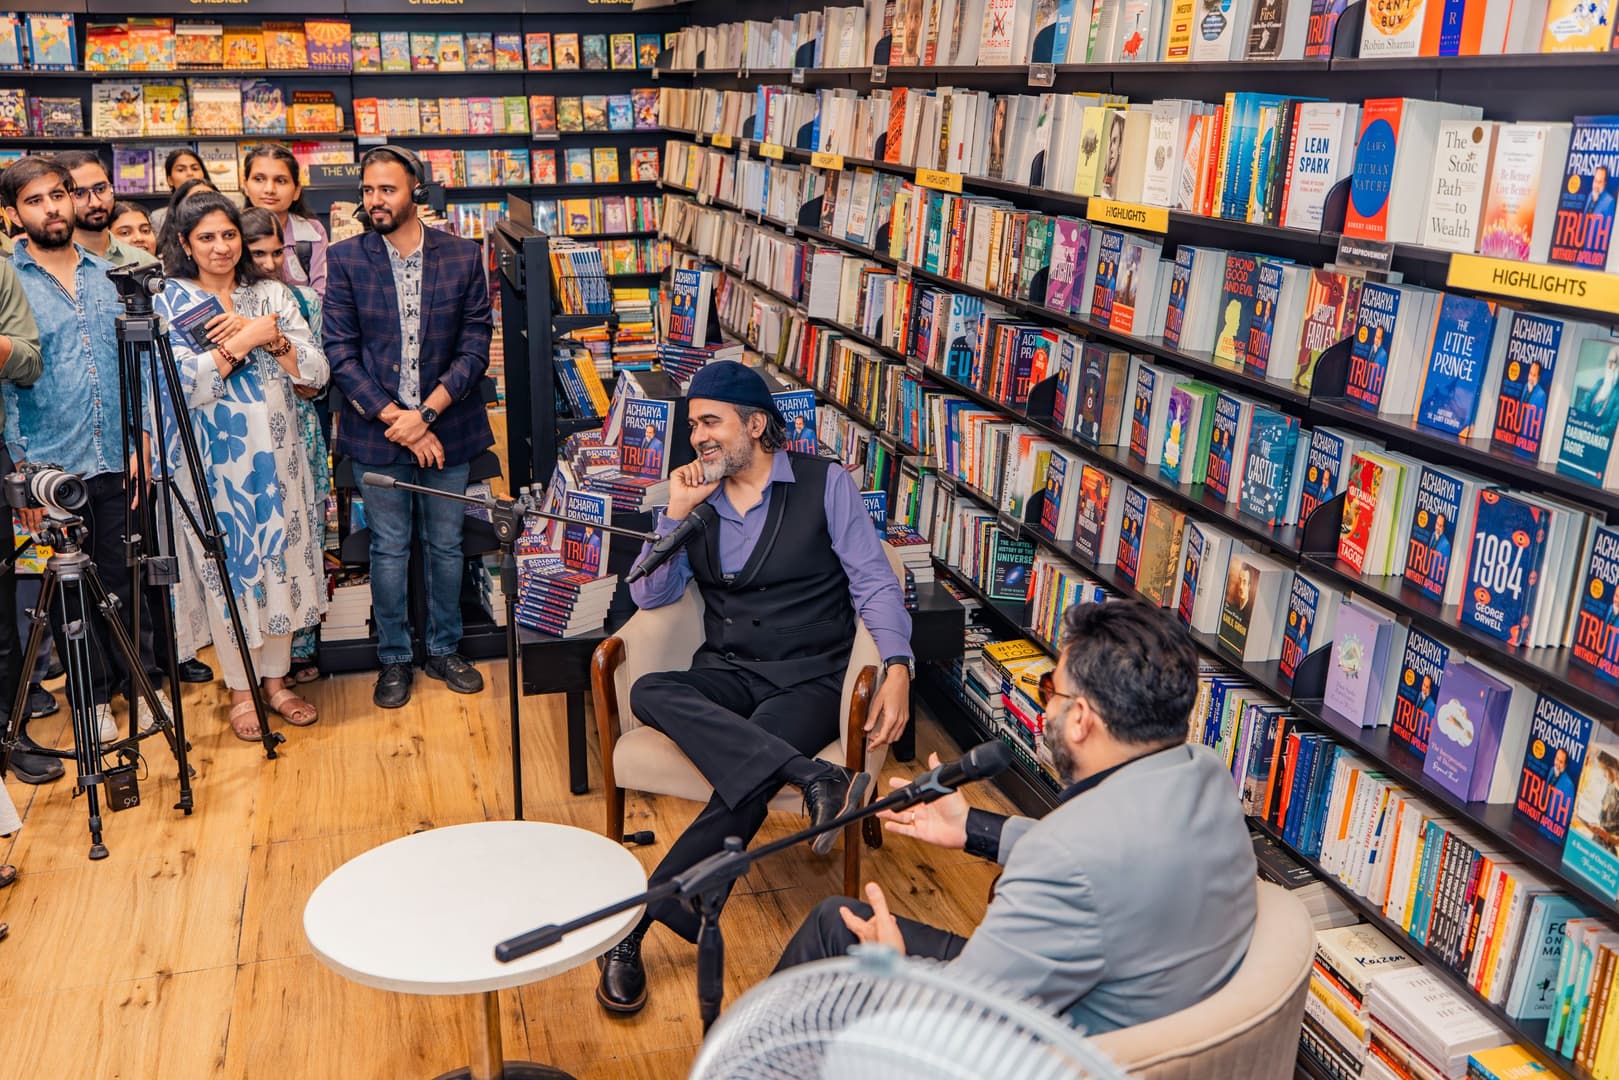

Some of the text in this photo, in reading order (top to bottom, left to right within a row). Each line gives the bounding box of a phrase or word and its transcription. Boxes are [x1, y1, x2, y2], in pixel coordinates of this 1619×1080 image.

[1308, 13, 1338, 44] TRUT
[1381, 15, 1404, 28] BUY
[311, 52, 349, 64] SIKHS
[1305, 137, 1330, 154] LEAN
[1366, 141, 1386, 150] LAWS
[1446, 130, 1468, 150] The
[320, 166, 343, 176] THE
[1300, 157, 1330, 174] SPARK
[1357, 164, 1389, 176] HUMAN
[1448, 154, 1478, 174] Stoic
[1354, 180, 1388, 192] NATURE
[1437, 178, 1462, 196] Path
[1106, 206, 1146, 222] HIGHLIGHTS
[1456, 201, 1467, 214] to
[1432, 217, 1470, 238] Wealth
[1556, 211, 1612, 250] TRUTH
[1227, 256, 1254, 272] BEYOND
[1552, 248, 1576, 262] WITHOUT
[675, 272, 697, 284] ACHARYA
[1226, 268, 1248, 282] GOOD
[1260, 266, 1280, 284] ACHARYA
[1493, 268, 1587, 296] HIGHLIGHTS
[674, 285, 698, 297] PRASHANT
[1094, 285, 1114, 312] TRUTH
[1224, 282, 1254, 297] AND EVIL
[1362, 287, 1394, 312] ACHARYA
[670, 314, 694, 334] TRUTH
[1167, 305, 1183, 331] TRUTH
[1312, 304, 1336, 324] AESOP'S
[1358, 307, 1396, 334] PRASHANT
[1306, 322, 1336, 352] FABLES
[1458, 320, 1470, 332] THE
[1512, 318, 1554, 346] ACHARYA
[1250, 328, 1270, 361] TRUTH
[1442, 331, 1476, 358] LITTLE
[1508, 340, 1556, 370] PRASHANT
[1350, 356, 1385, 394] TRUTH
[1432, 352, 1476, 382] PRINCE
[626, 402, 662, 418] ACHARYA
[776, 398, 809, 411] CHARYA
[625, 416, 666, 432] PRASHANT
[782, 410, 814, 423] ASHANT
[1498, 395, 1544, 440] TRUTH
[1261, 440, 1272, 459] THE
[1312, 432, 1339, 458] ACHARYA
[1563, 438, 1584, 458] TAGORE
[623, 445, 662, 468] TRUTH
[1309, 449, 1340, 478] PRASHANT
[1208, 452, 1230, 484] TRUTH
[1248, 453, 1279, 490] CASTLE
[1420, 472, 1456, 502] ACHARYA
[568, 498, 600, 514] ACHARYA
[1418, 490, 1458, 524] PRASHANT
[566, 540, 600, 564] TRUTH
[998, 553, 1033, 564] UNIVERSE
[1119, 538, 1136, 570] TRUTH
[1340, 544, 1363, 568] TAGORE
[1406, 539, 1448, 583] TRUTH
[1473, 532, 1524, 600] 1984
[1293, 577, 1314, 606] ACHARYA
[1290, 595, 1315, 624] PRASHANT
[1476, 602, 1504, 622] GEORGE
[1474, 612, 1502, 632] ORWELL
[1408, 632, 1441, 666] ACHARYA
[1404, 651, 1444, 687] PRASHANT
[1396, 694, 1434, 742] TRUTH
[1536, 699, 1581, 739] ACHARYA
[1532, 719, 1584, 764] PRASHANT
[124, 796, 138, 808] 99
[1518, 768, 1571, 826] TRUTH
[1518, 799, 1565, 838] WITHOUT APOLOGY
[1355, 955, 1406, 968] Kaizen
